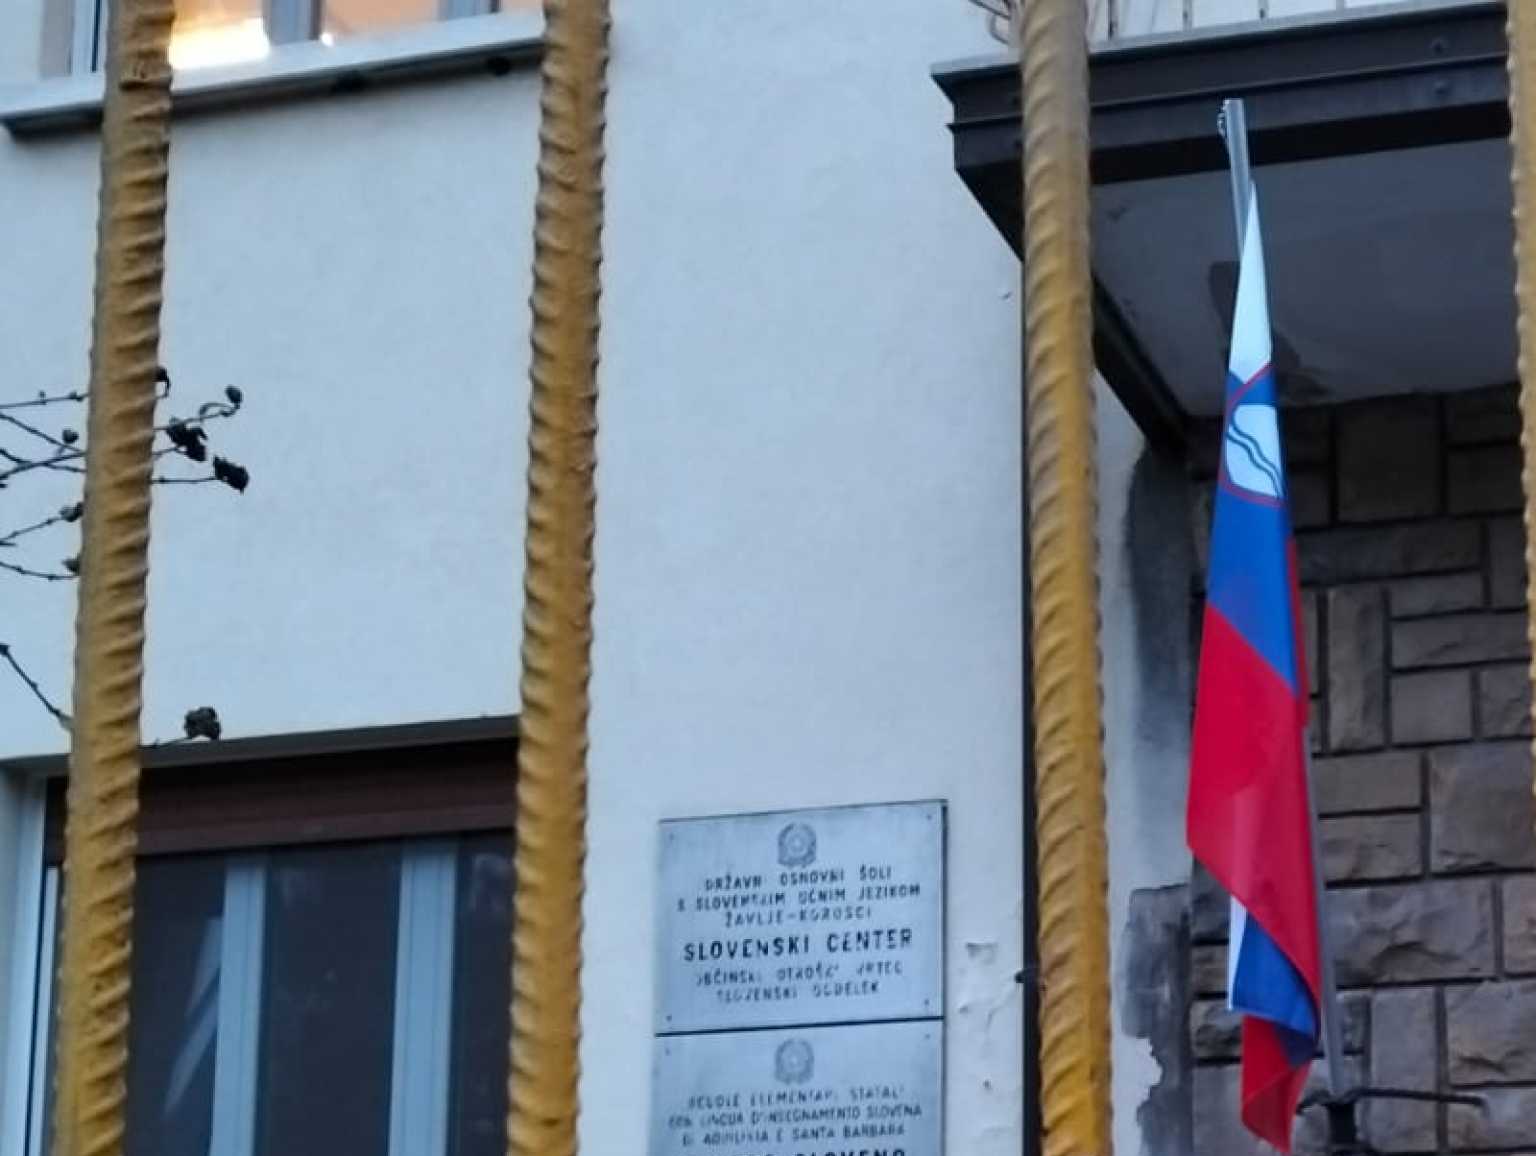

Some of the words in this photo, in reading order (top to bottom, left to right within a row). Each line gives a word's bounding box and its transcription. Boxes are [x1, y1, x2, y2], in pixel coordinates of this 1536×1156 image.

[859, 864, 892, 881] ŠOLI
[683, 934, 810, 962] SLOVENSKI
[826, 928, 914, 953] CENTER
